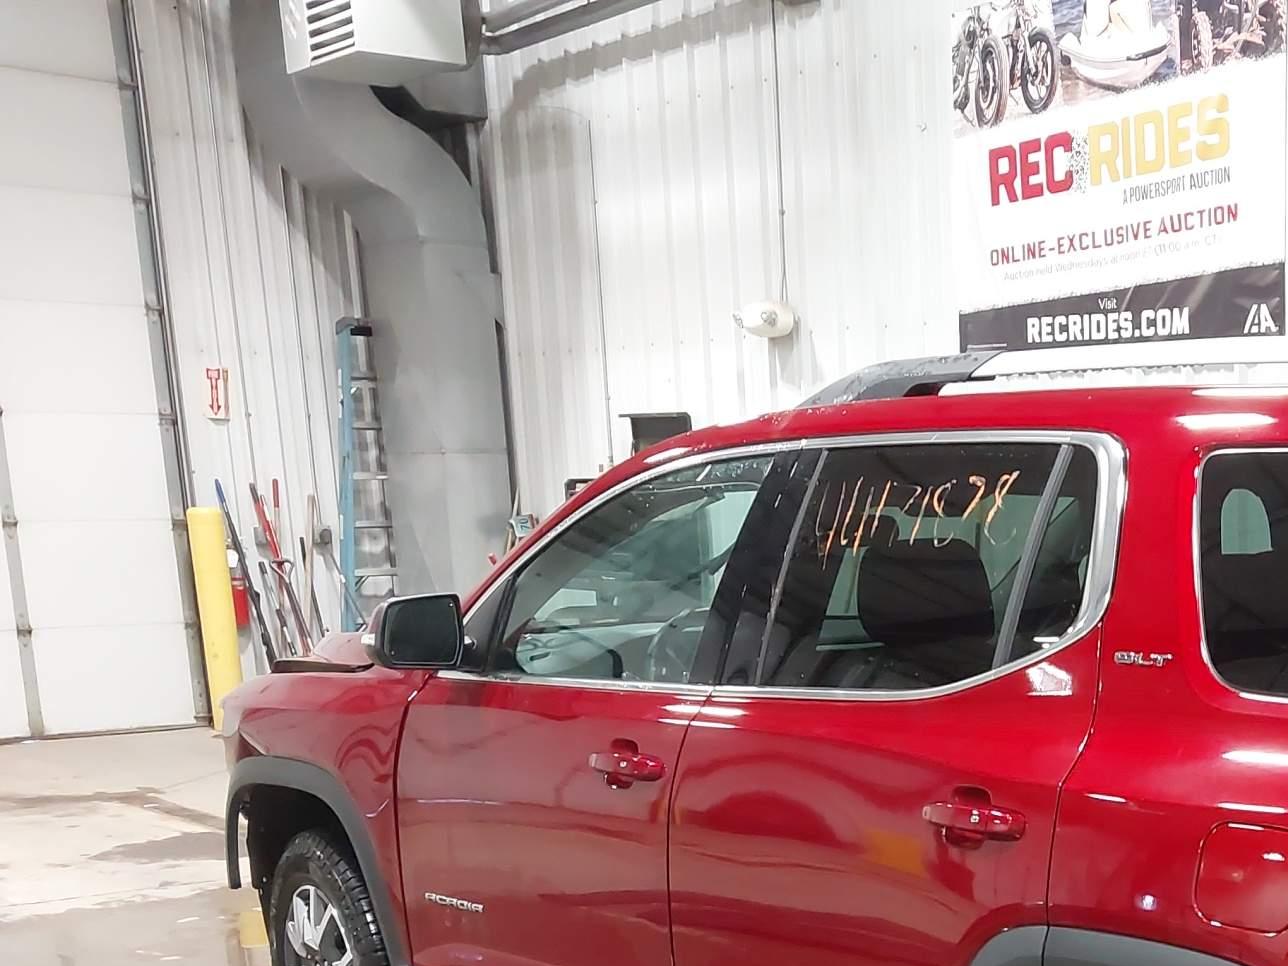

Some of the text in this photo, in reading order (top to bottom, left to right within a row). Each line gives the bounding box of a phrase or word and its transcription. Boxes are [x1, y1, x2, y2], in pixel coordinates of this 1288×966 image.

[989, 94, 1231, 206] REC RIDES
[1122, 166, 1231, 205] A POWERSPORT AUCTION
[990, 203, 1239, 266] ONLINE-EXCLUSIVE AUCTION
[1098, 297, 1118, 310] Visit
[1026, 306, 1190, 344] RECRIDES.COM
[424, 892, 484, 912] ACADIA
